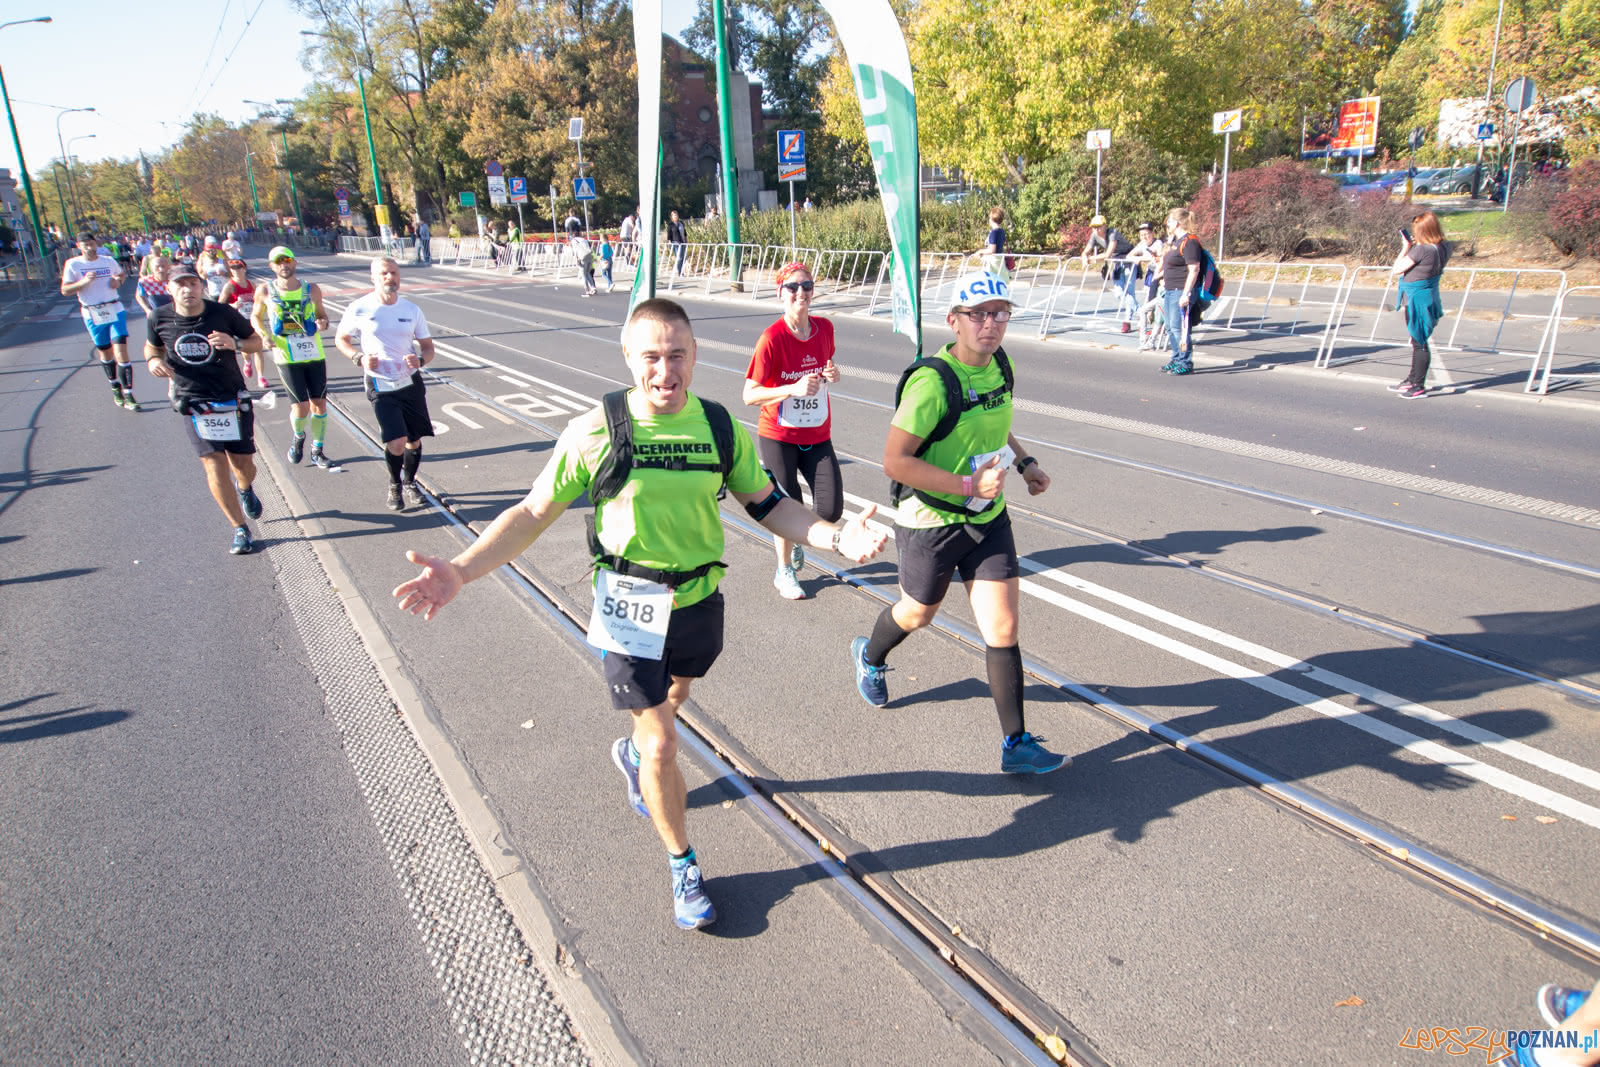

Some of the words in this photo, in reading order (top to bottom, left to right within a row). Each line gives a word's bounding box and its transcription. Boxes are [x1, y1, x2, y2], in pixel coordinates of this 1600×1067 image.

[793, 398, 819, 410] 3165
[203, 418, 231, 428] 3546
[632, 443, 713, 455] ACEMAKER
[602, 596, 654, 624] 5818
